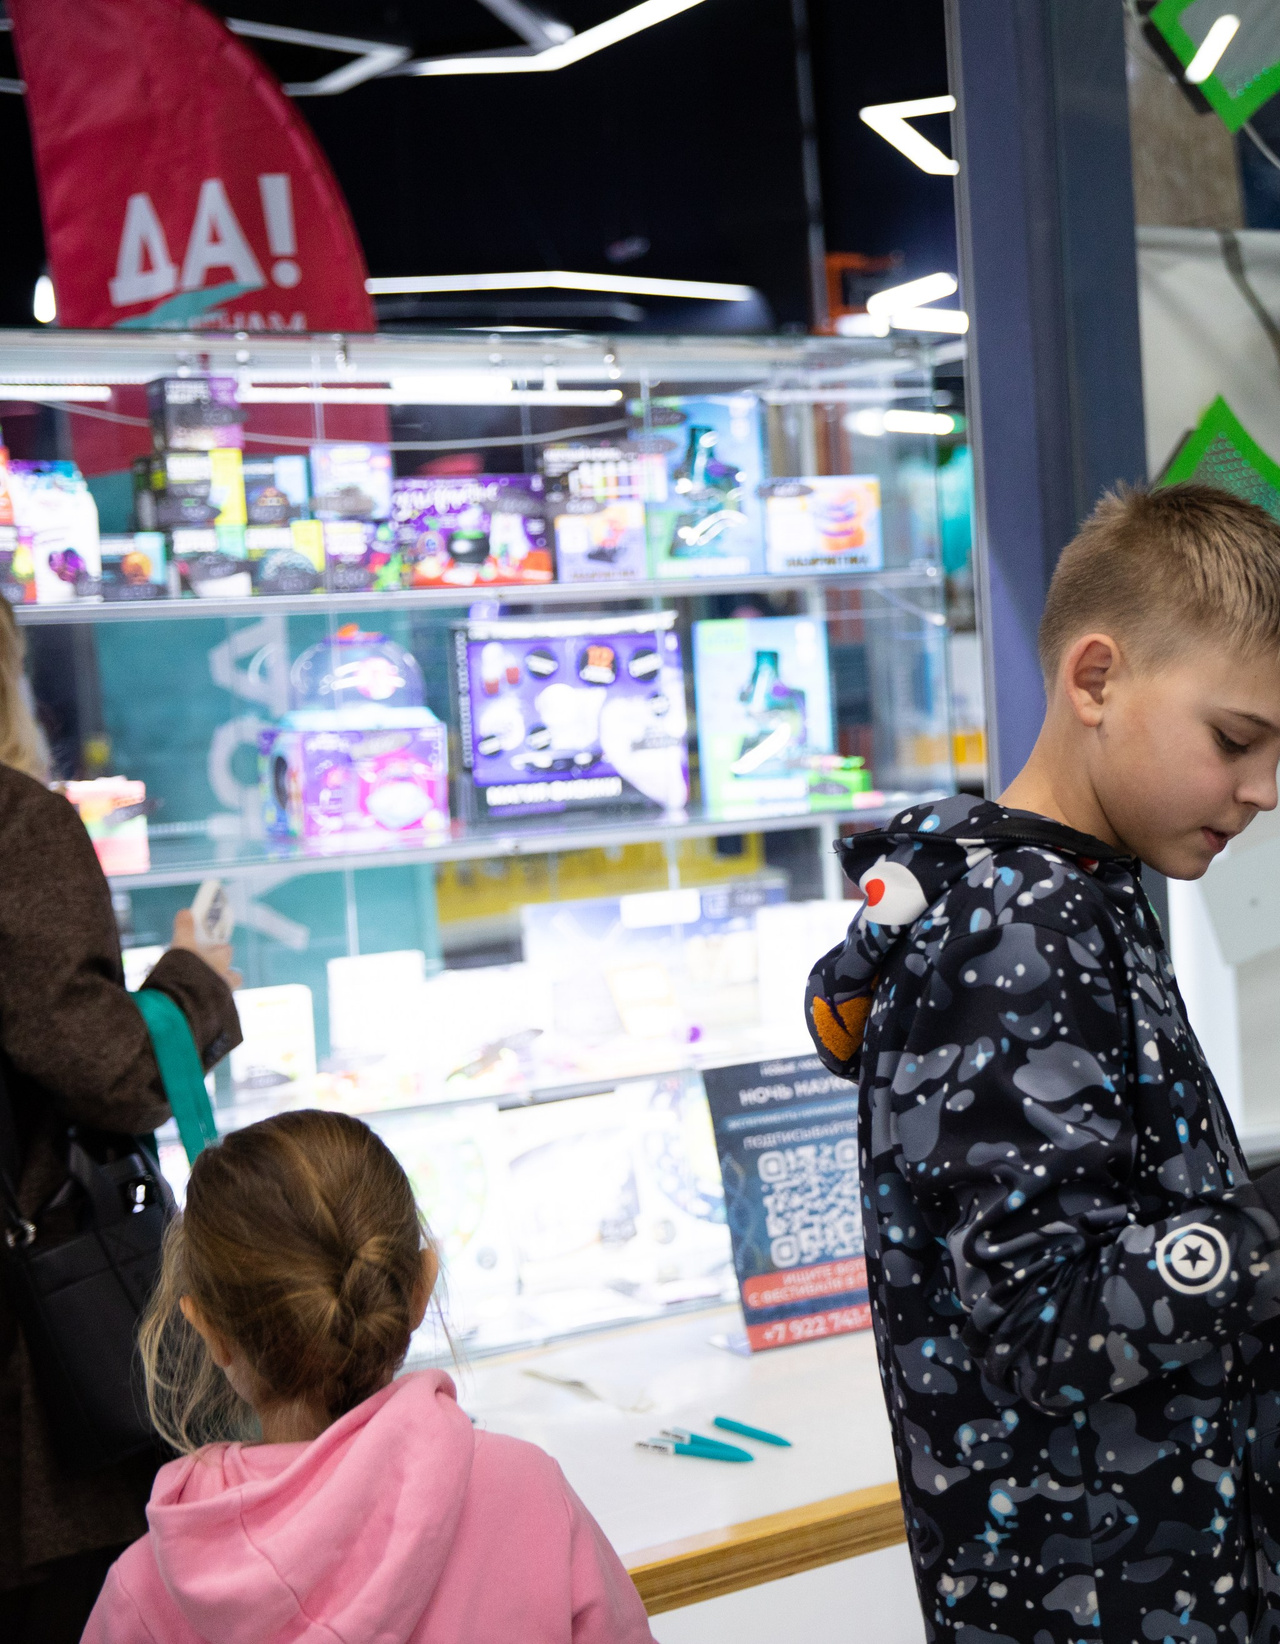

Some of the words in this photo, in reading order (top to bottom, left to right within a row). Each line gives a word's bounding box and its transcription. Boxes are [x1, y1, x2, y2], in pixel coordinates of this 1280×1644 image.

[108, 172, 302, 307] ДА!
[738, 1082, 794, 1107] НОЧЬ
[763, 1322, 786, 1341] +7
[788, 1315, 828, 1339] 922
